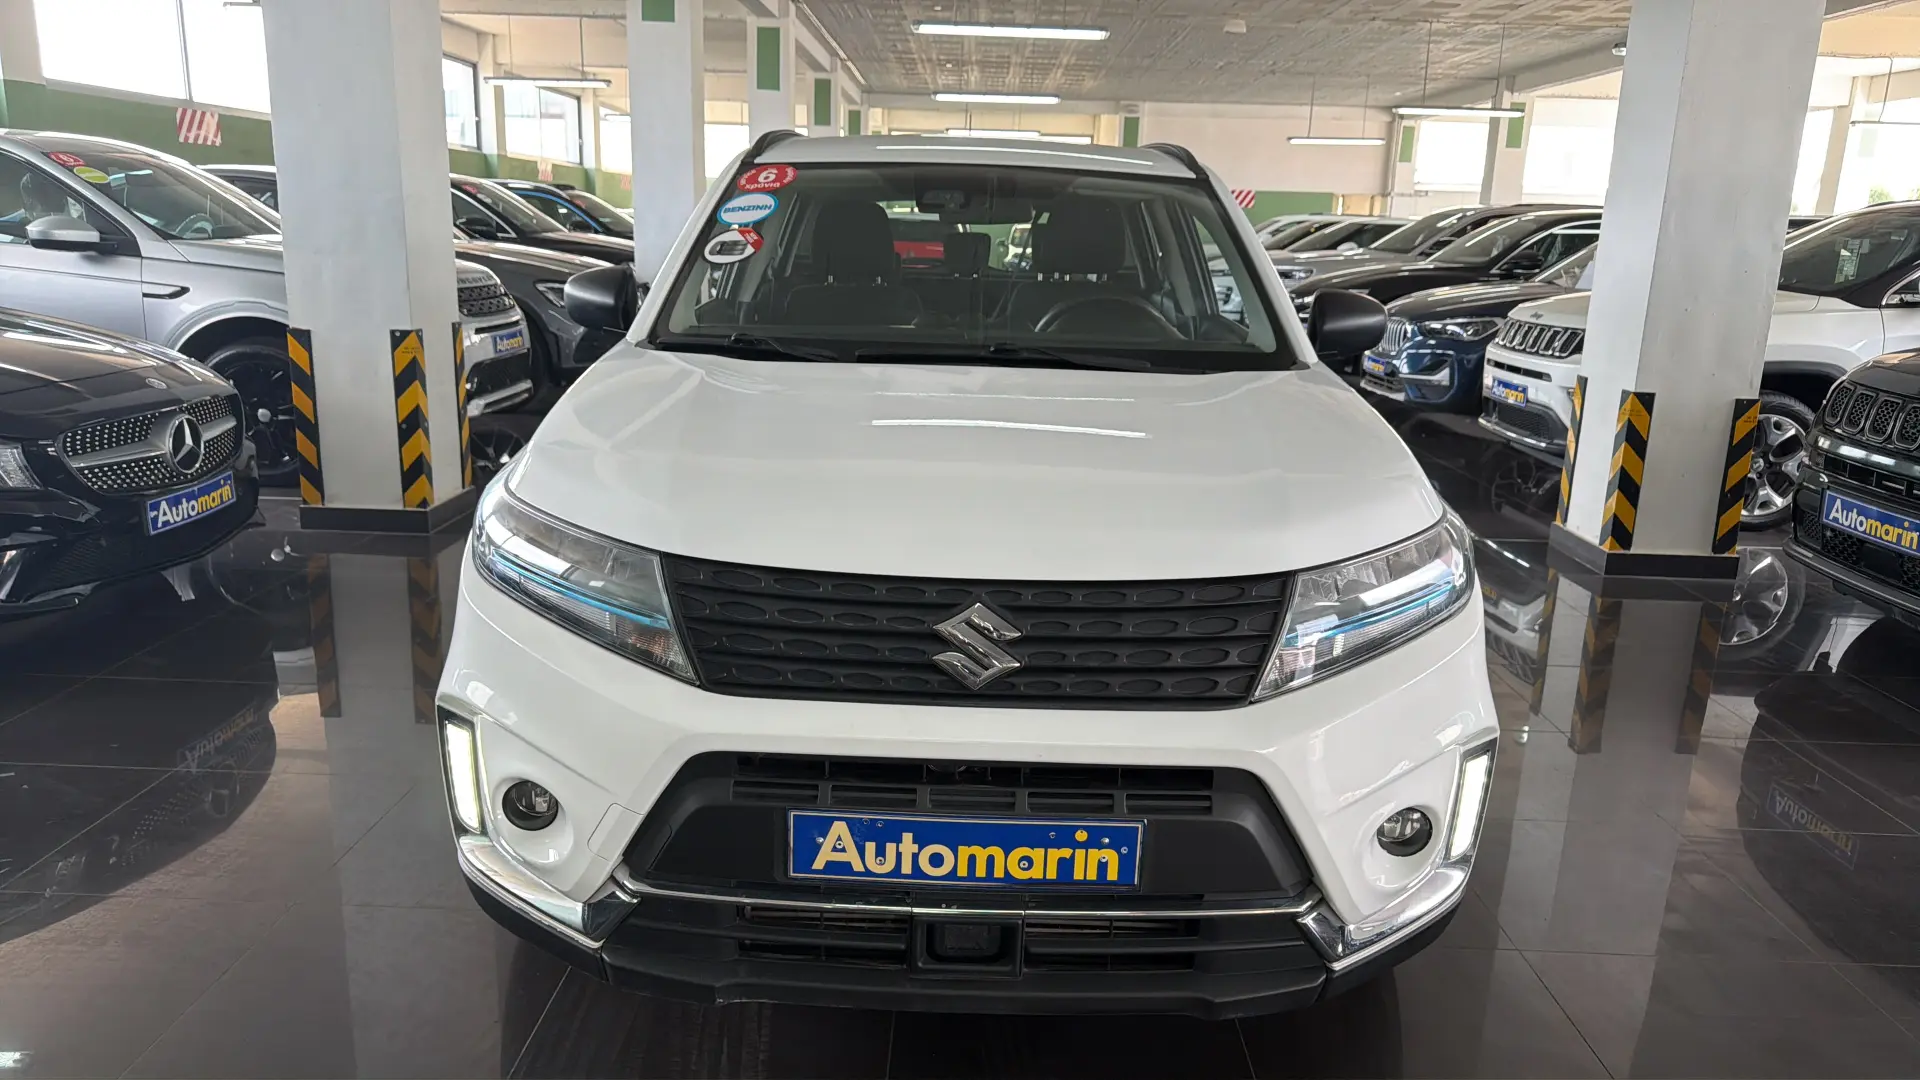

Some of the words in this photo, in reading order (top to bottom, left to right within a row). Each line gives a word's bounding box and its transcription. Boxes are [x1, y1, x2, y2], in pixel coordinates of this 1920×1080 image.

[758, 168, 779, 183] 6
[157, 478, 233, 529] Automarin
[1828, 498, 1919, 551] Automarin
[811, 820, 1119, 881] Automarin
